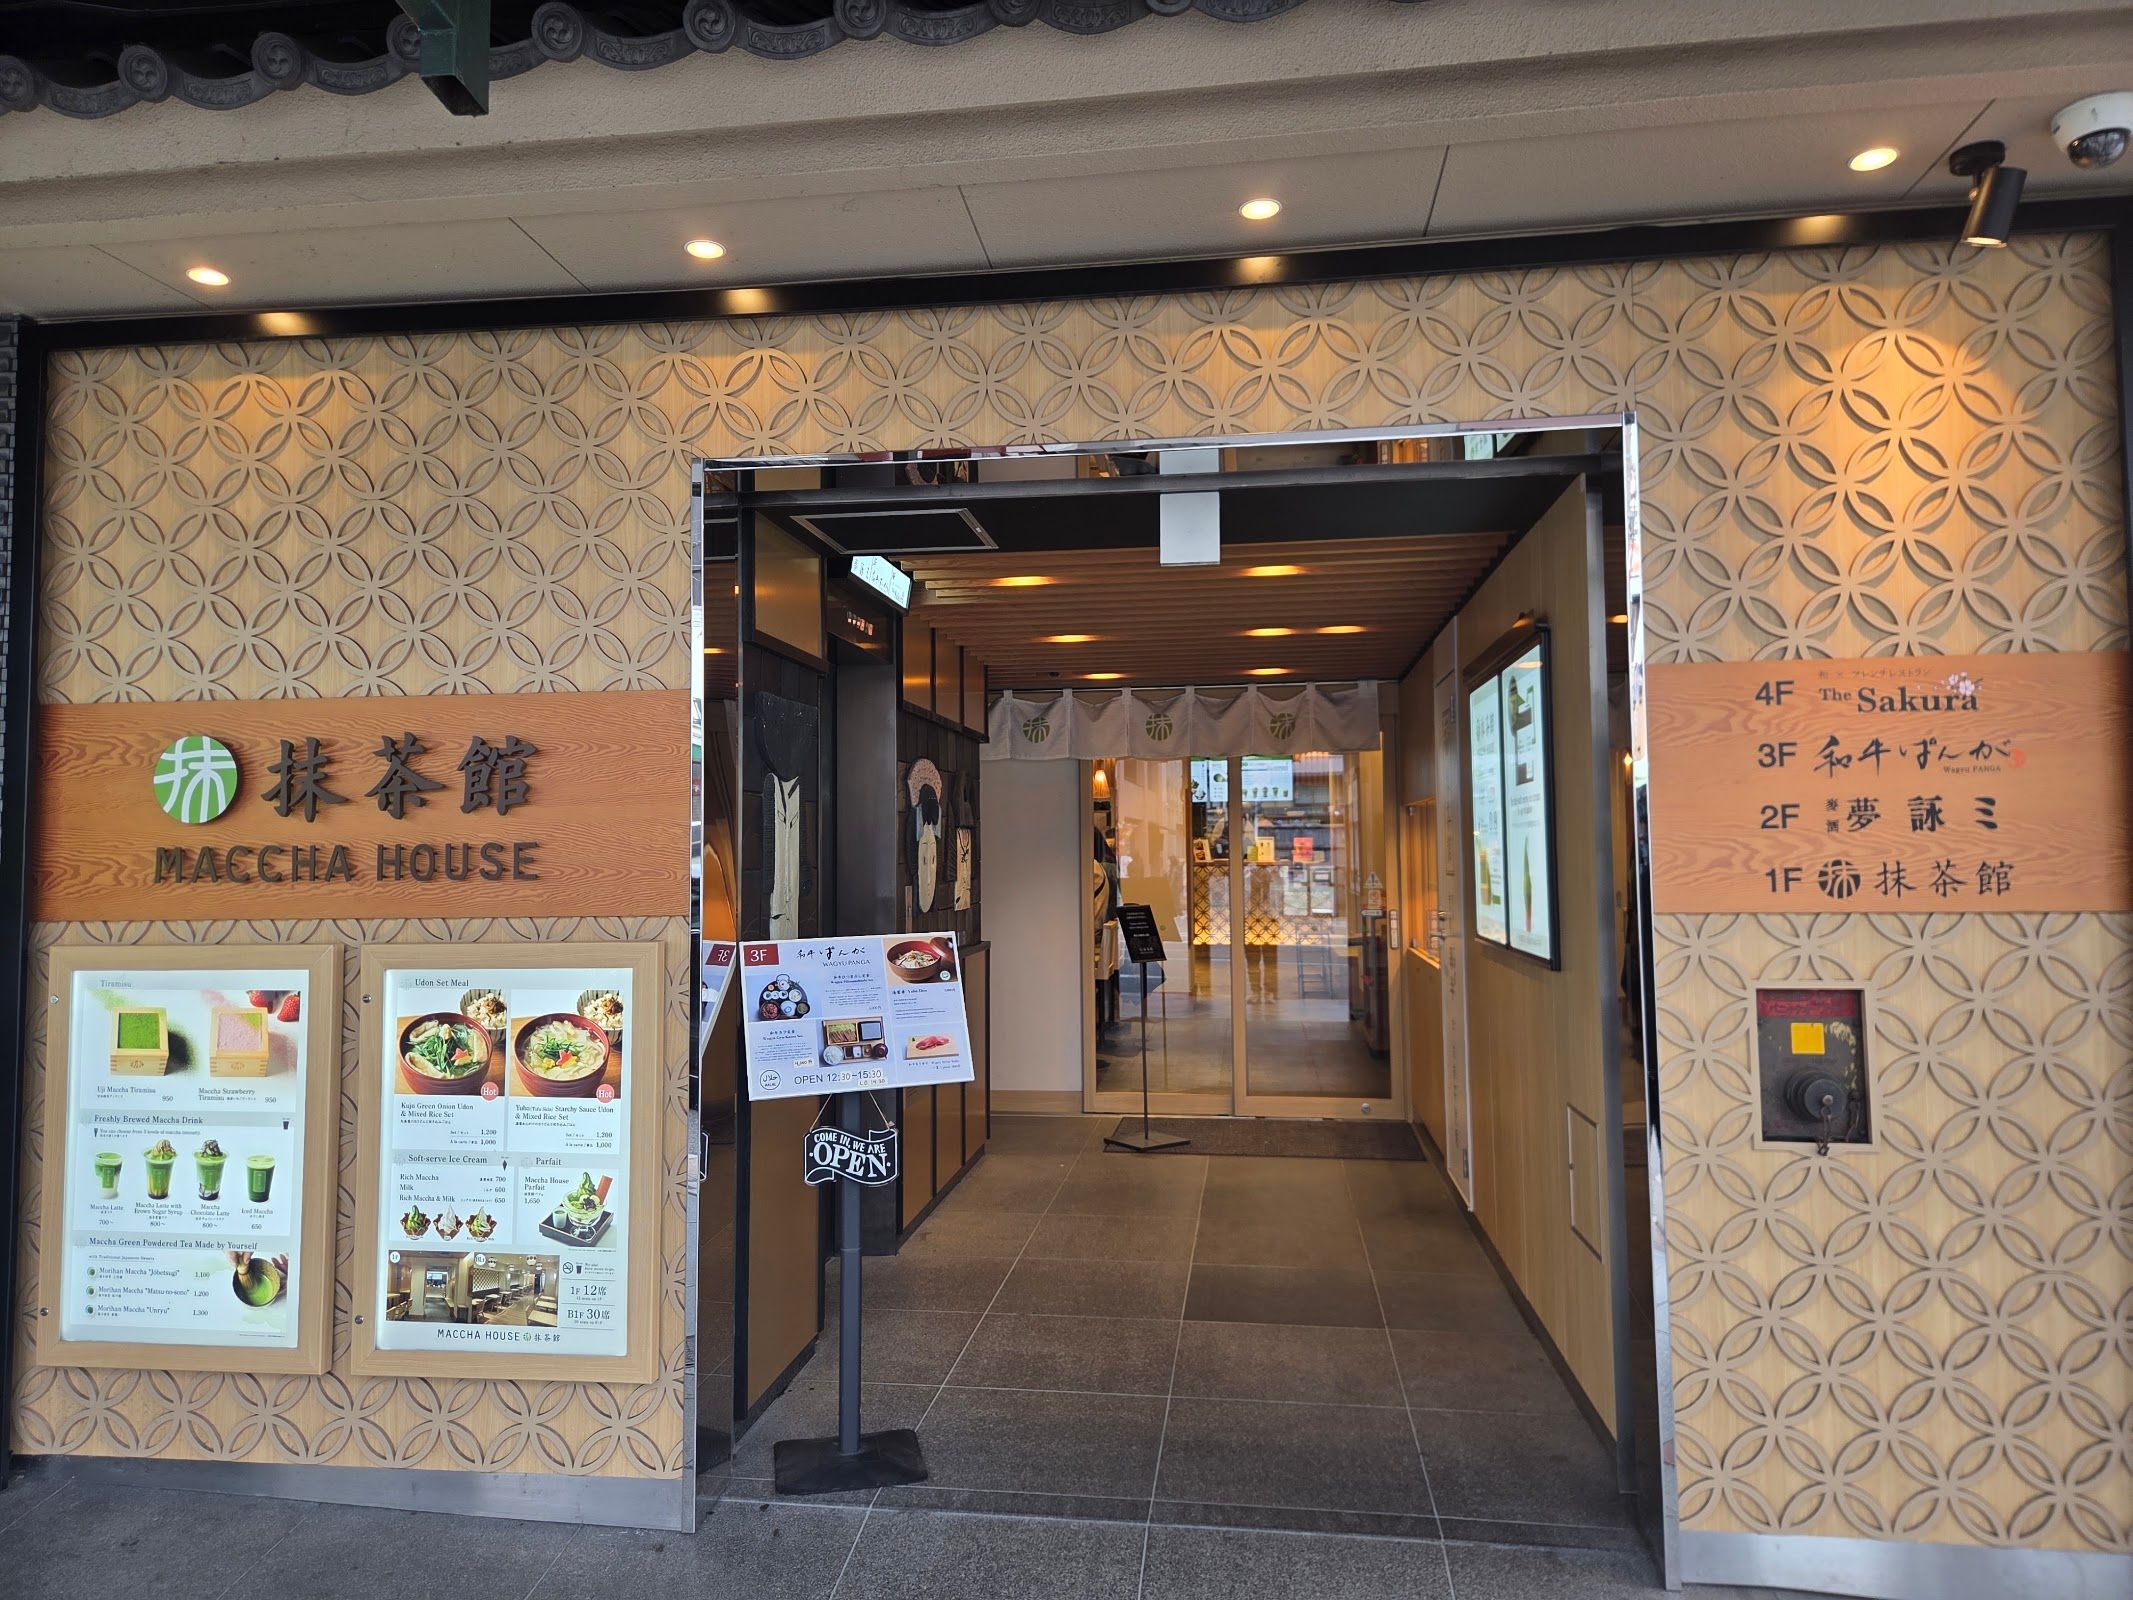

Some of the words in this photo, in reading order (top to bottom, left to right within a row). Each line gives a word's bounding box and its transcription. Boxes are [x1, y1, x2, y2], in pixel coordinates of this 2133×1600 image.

[1755, 680, 1794, 706] 4F
[1819, 688, 1852, 702] The
[1857, 686, 1979, 713] Sakura
[1758, 742, 1797, 768] 3F
[1973, 765, 2002, 773] PANGA
[261, 732, 536, 823] 抹茶館
[1760, 803, 1800, 829] 2F
[155, 844, 355, 884] MACCHA
[376, 842, 541, 882] HOUSE
[1765, 867, 1803, 893] 1F
[1874, 858, 2015, 898] 抹茶館
[750, 949, 768, 962] 3F
[101, 980, 132, 988] Tiramisu
[415, 979, 434, 987] Udon
[436, 979, 448, 987] Set
[451, 979, 469, 987] Meal
[795, 1075, 823, 1085] OPEN
[223, 1088, 256, 1096] Strawberry
[483, 1088, 497, 1096] Hot
[599, 1090, 613, 1098] Hot
[401, 1102, 416, 1110] Kujo
[95, 1115, 120, 1123] Freshly
[153, 1116, 180, 1124] Maccha
[814, 1133, 838, 1143] COME
[853, 1140, 866, 1152] WE
[868, 1144, 886, 1154] ARE
[408, 1155, 447, 1163] Soft-serve
[463, 1156, 488, 1164] Cream
[814, 1142, 888, 1178] OPEN
[89, 1238, 117, 1246] Maccha
[119, 1239, 141, 1247] Green
[143, 1239, 178, 1248] Powdered
[180, 1240, 193, 1248] Tea
[195, 1241, 215, 1249] Made
[217, 1242, 225, 1250] by
[228, 1242, 258, 1250] Yourself
[571, 1287, 580, 1295] 1F
[568, 1310, 584, 1319] B1F
[438, 1329, 481, 1340] MACCHA
[486, 1331, 520, 1341] HOUSE
